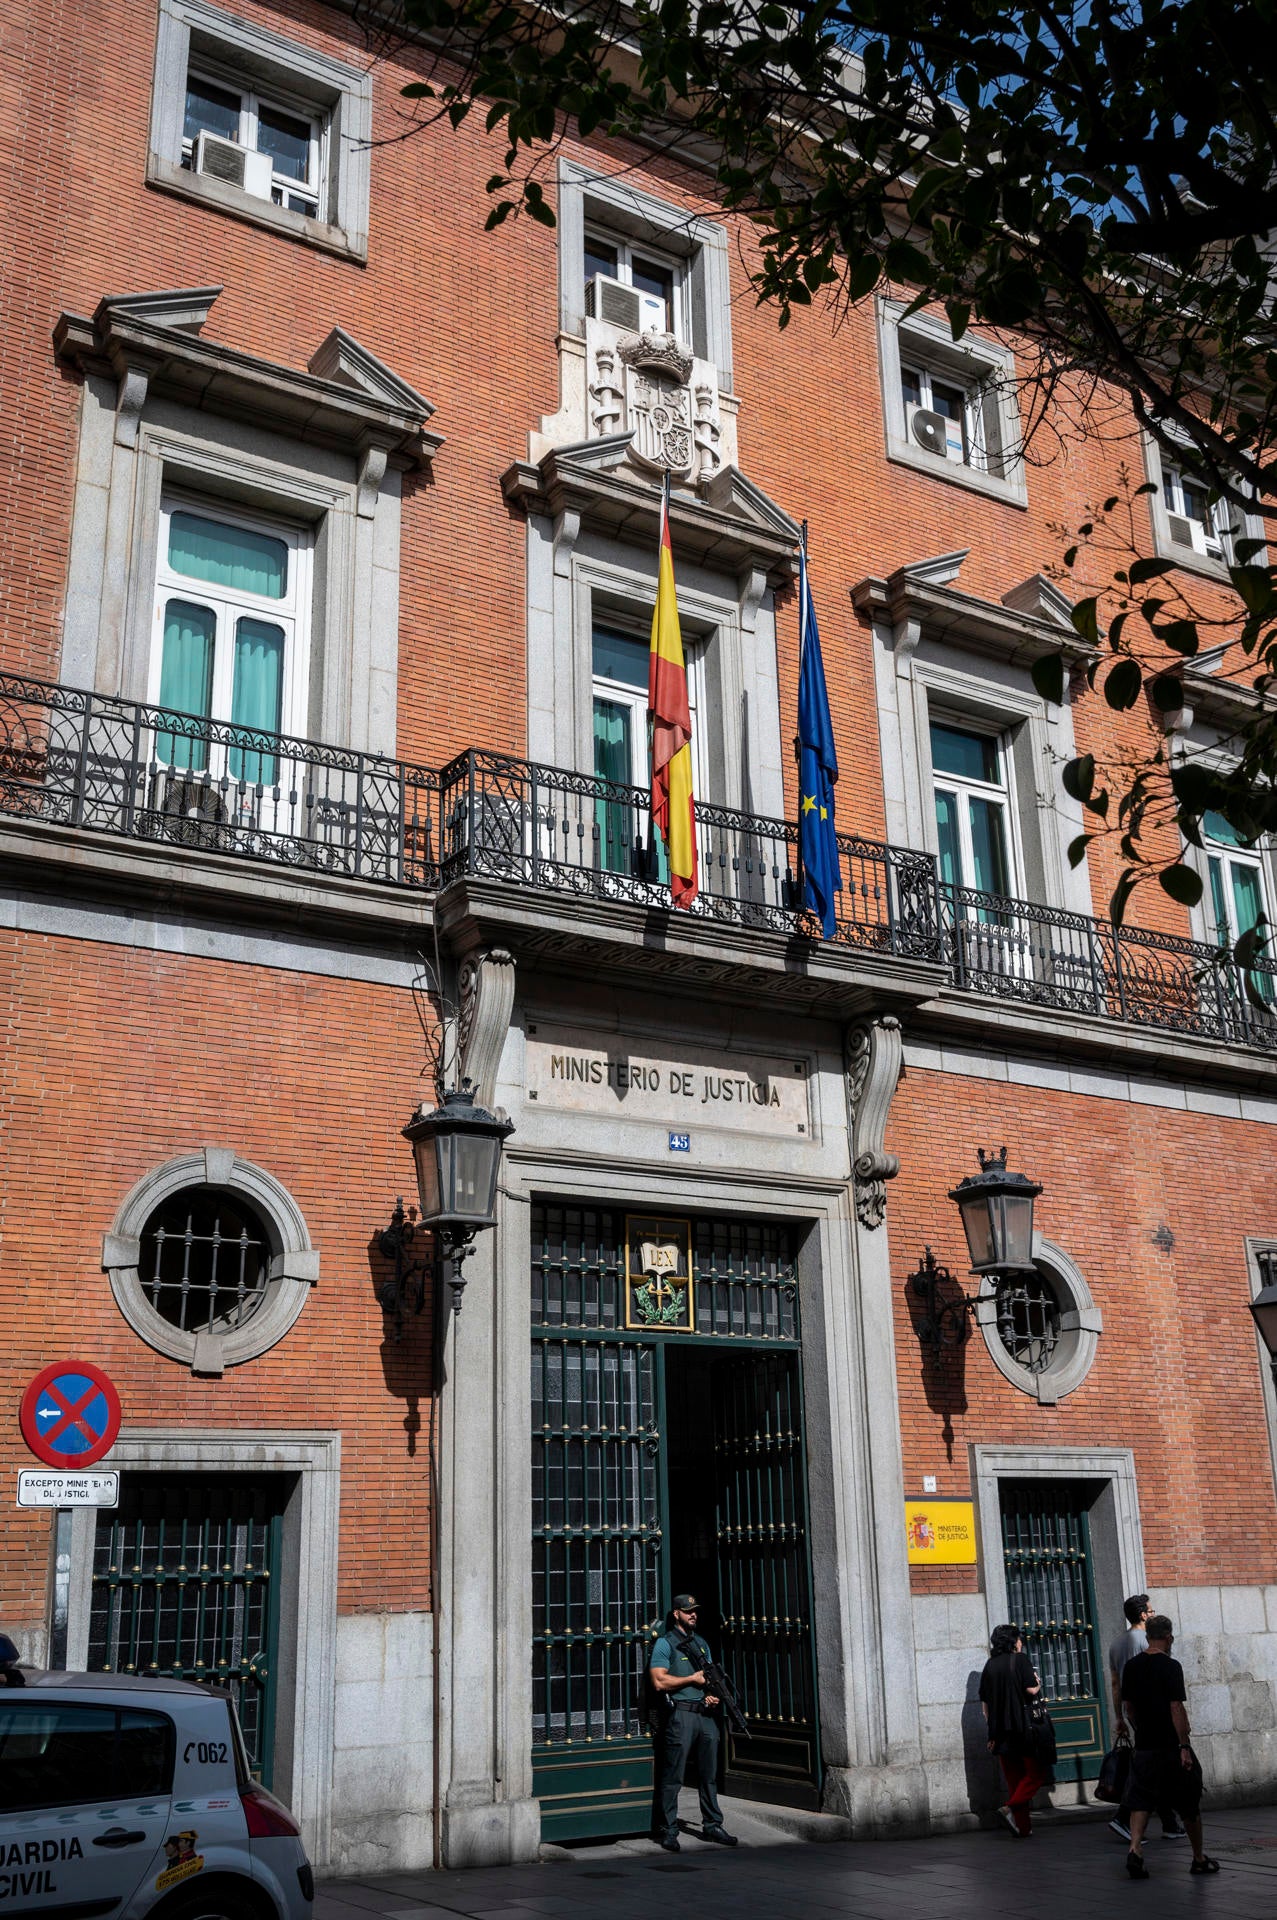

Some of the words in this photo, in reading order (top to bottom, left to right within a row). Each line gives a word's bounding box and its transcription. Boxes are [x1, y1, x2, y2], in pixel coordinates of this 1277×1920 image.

[551, 1054, 660, 1091] MINISTERIO
[669, 1071, 694, 1097] DE
[701, 1075, 781, 1108] JUSTICIA
[670, 1135, 689, 1150] 45
[650, 1249, 674, 1267] LEX
[24, 1479, 64, 1487] EXCEPTO
[937, 1525, 968, 1533] MINISTERIO
[946, 1533, 969, 1541] JUSTICIA
[197, 1742, 228, 1764] 062
